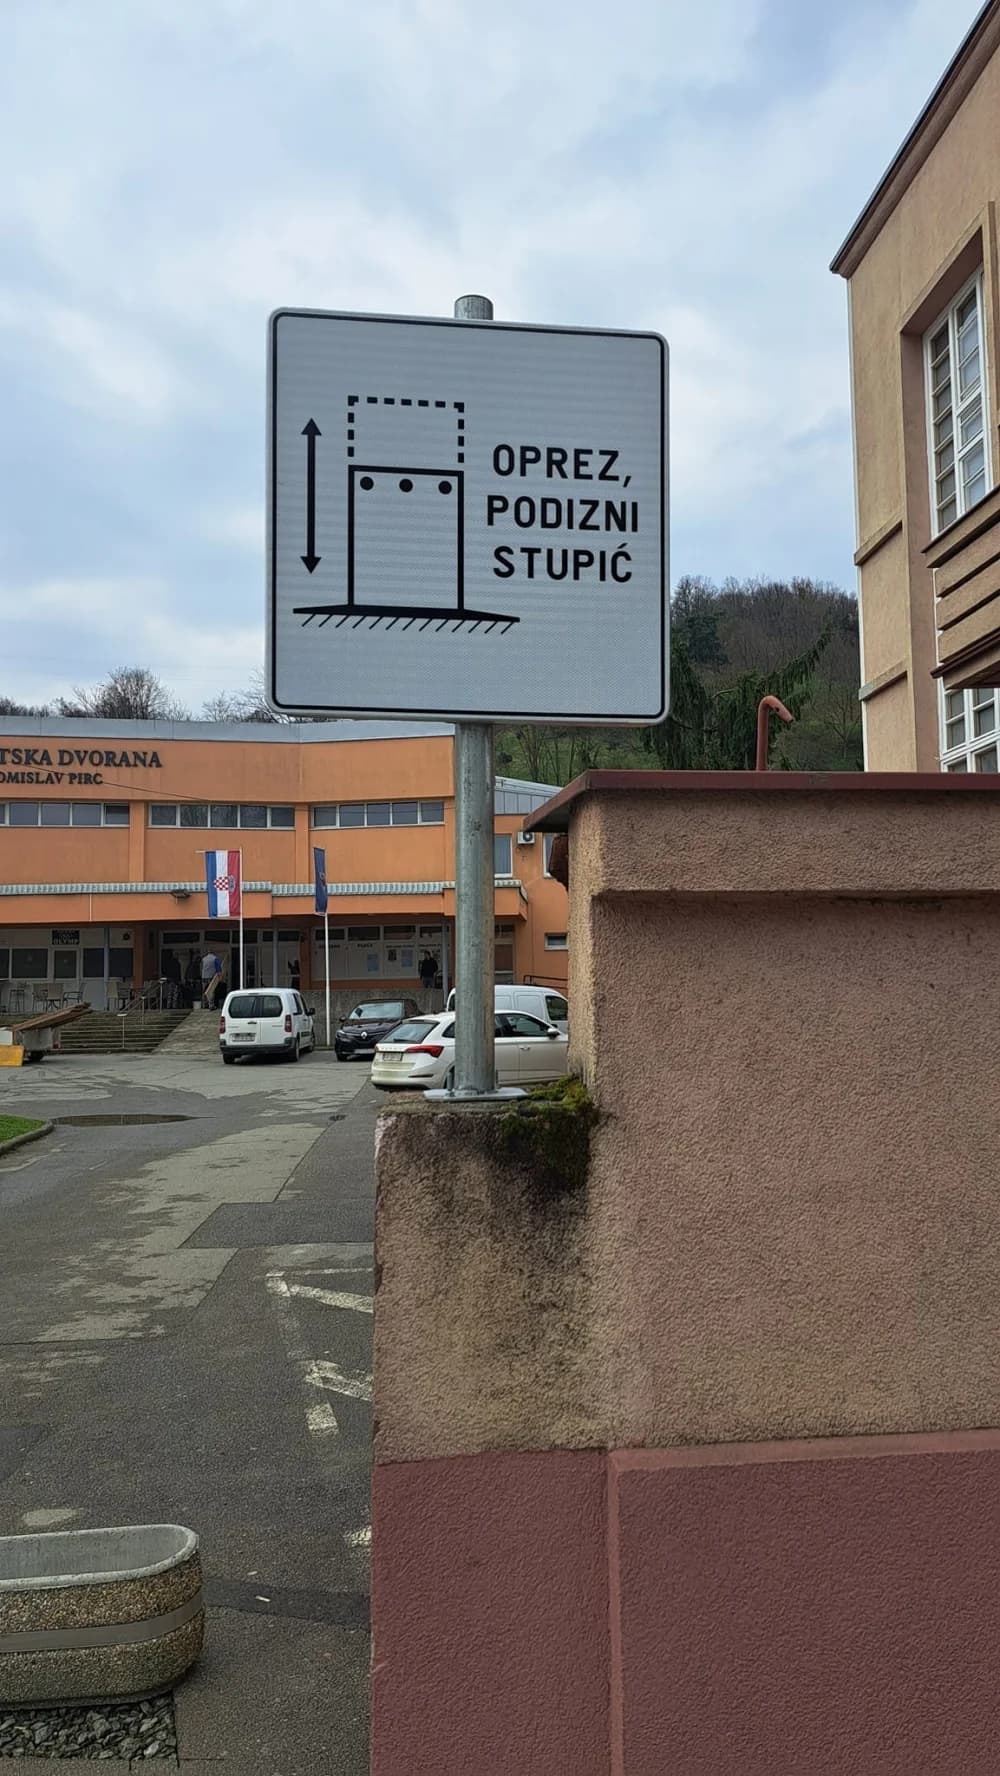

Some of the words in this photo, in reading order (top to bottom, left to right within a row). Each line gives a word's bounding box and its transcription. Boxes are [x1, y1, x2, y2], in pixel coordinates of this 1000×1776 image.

[493, 444, 632, 488] OPREZ,
[487, 495, 638, 532] PODIZNI
[493, 543, 632, 583] STUPIĆ
[58, 750, 162, 768] DVORANA
[69, 773, 103, 785] PIRC
